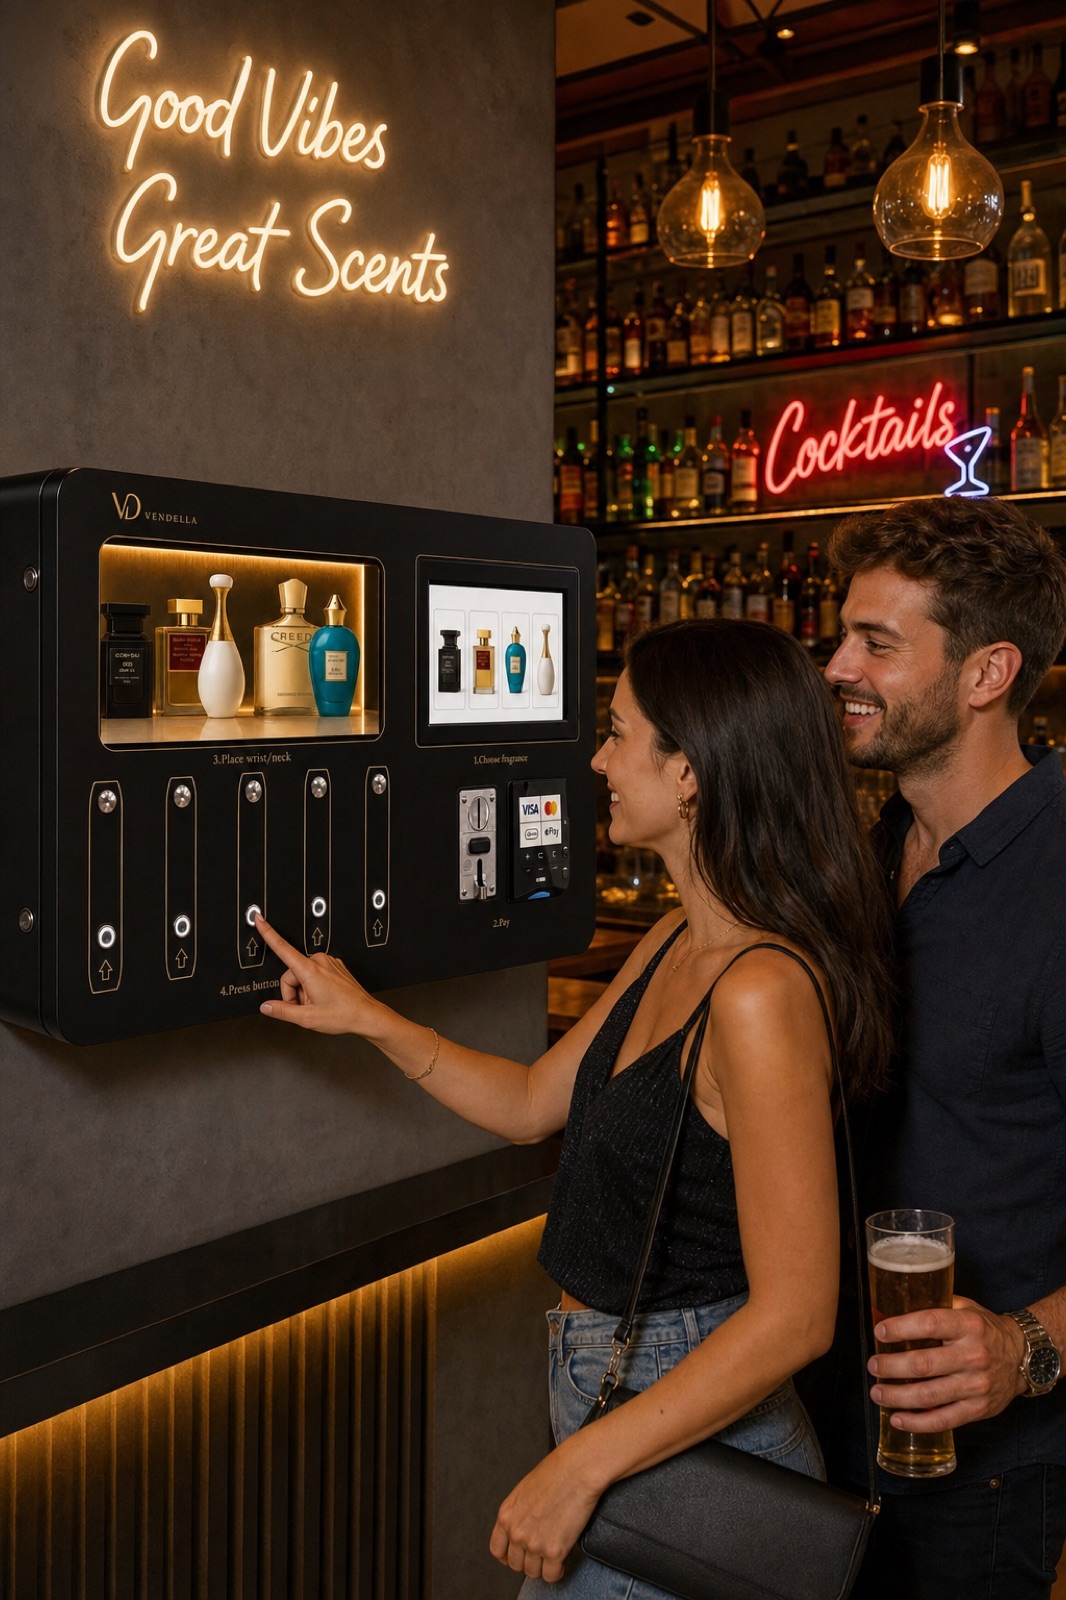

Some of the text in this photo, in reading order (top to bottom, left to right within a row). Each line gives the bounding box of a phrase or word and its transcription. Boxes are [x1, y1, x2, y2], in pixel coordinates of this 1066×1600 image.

[100, 30, 388, 170] Good Vibes
[116, 172, 449, 312] Great Scents
[765, 381, 955, 494] Cocktails
[144, 511, 198, 525] VENDELLA
[270, 631, 312, 642] CREED
[213, 751, 292, 765] 3.Place wrist/neck
[522, 803, 539, 816] VISA
[219, 980, 280, 996] 4.Press button
